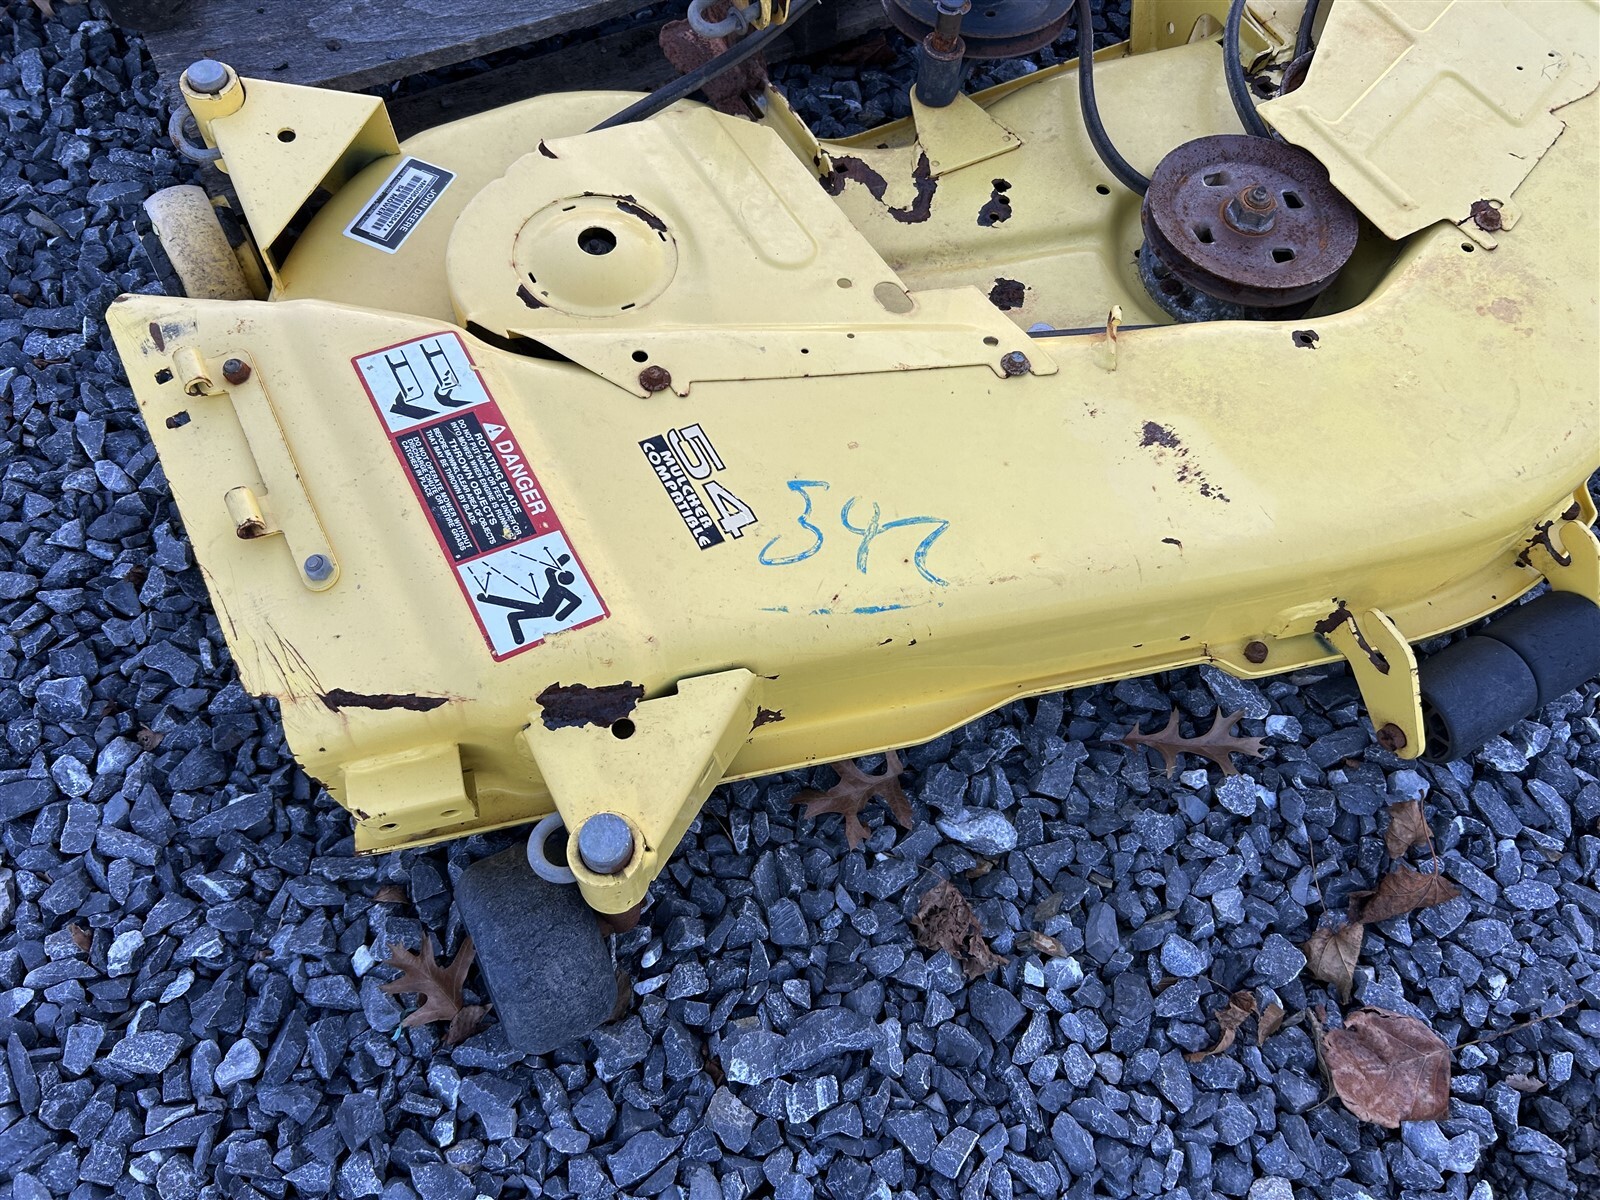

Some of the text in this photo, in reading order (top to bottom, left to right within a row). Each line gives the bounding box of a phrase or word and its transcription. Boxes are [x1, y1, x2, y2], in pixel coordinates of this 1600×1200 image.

[375, 192, 397, 215] MOWER
[398, 208, 422, 232] DEERE
[418, 188, 438, 208] JOHN
[400, 440, 433, 497] CATCHER IN PLACE
[406, 438, 467, 551] DISCHARGE CHUTE OR ENTIRE GRASS
[412, 436, 473, 548] DO NOT OPERATE MOWER WITHOUT
[424, 430, 478, 525] THAT MAY BE THROWN BY BLADE
[432, 427, 497, 544] BEFORE MOWING, CLEAR AREA OF OBJECTS
[447, 438, 498, 525] THROWN OBJECTS
[449, 421, 462, 436] INTO
[457, 436, 474, 459] MOWER
[469, 459, 484, 478] WHEN
[479, 478, 496, 501] ENGINE
[491, 501, 500, 509] IS
[456, 419, 523, 535] DO NOT PUT HANDS OR FEET UNDER OR
[473, 432, 522, 514] ROTATING BLADE
[494, 439, 548, 515] DANGER
[640, 441, 710, 547] COMPATIBLE
[659, 449, 713, 529] MULCHER
[667, 422, 758, 539] 54
